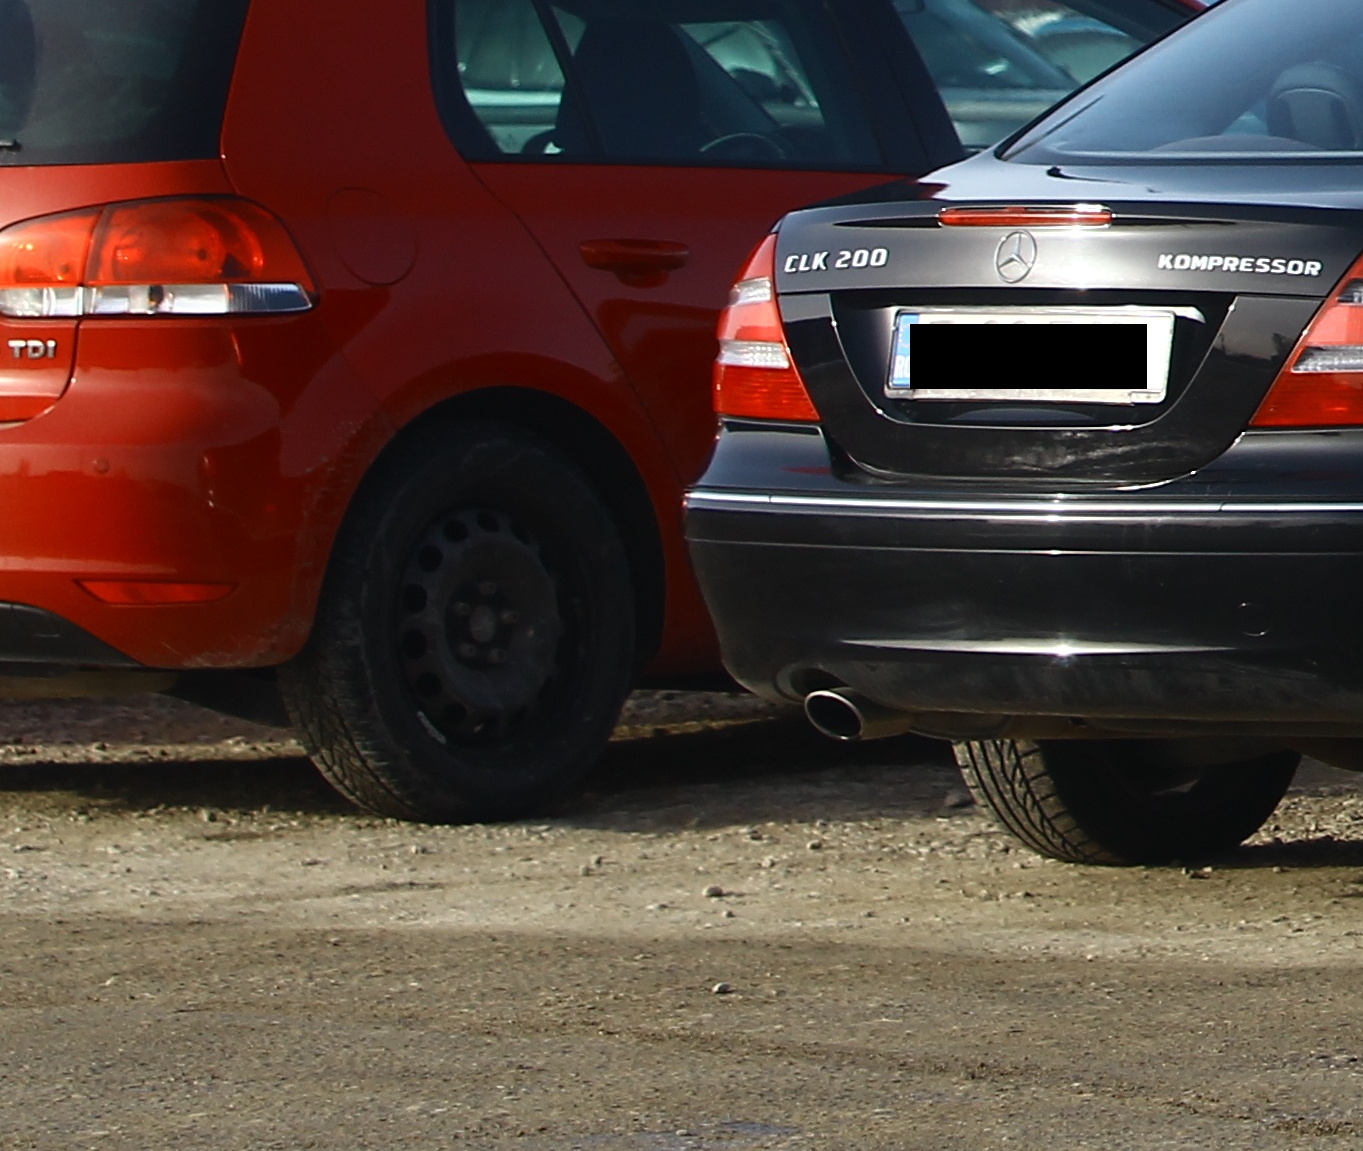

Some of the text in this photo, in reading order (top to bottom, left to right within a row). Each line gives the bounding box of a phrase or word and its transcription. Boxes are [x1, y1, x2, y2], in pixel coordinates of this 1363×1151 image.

[784, 248, 888, 273] CLK 200
[1157, 253, 1322, 276] KOMPRESSOR
